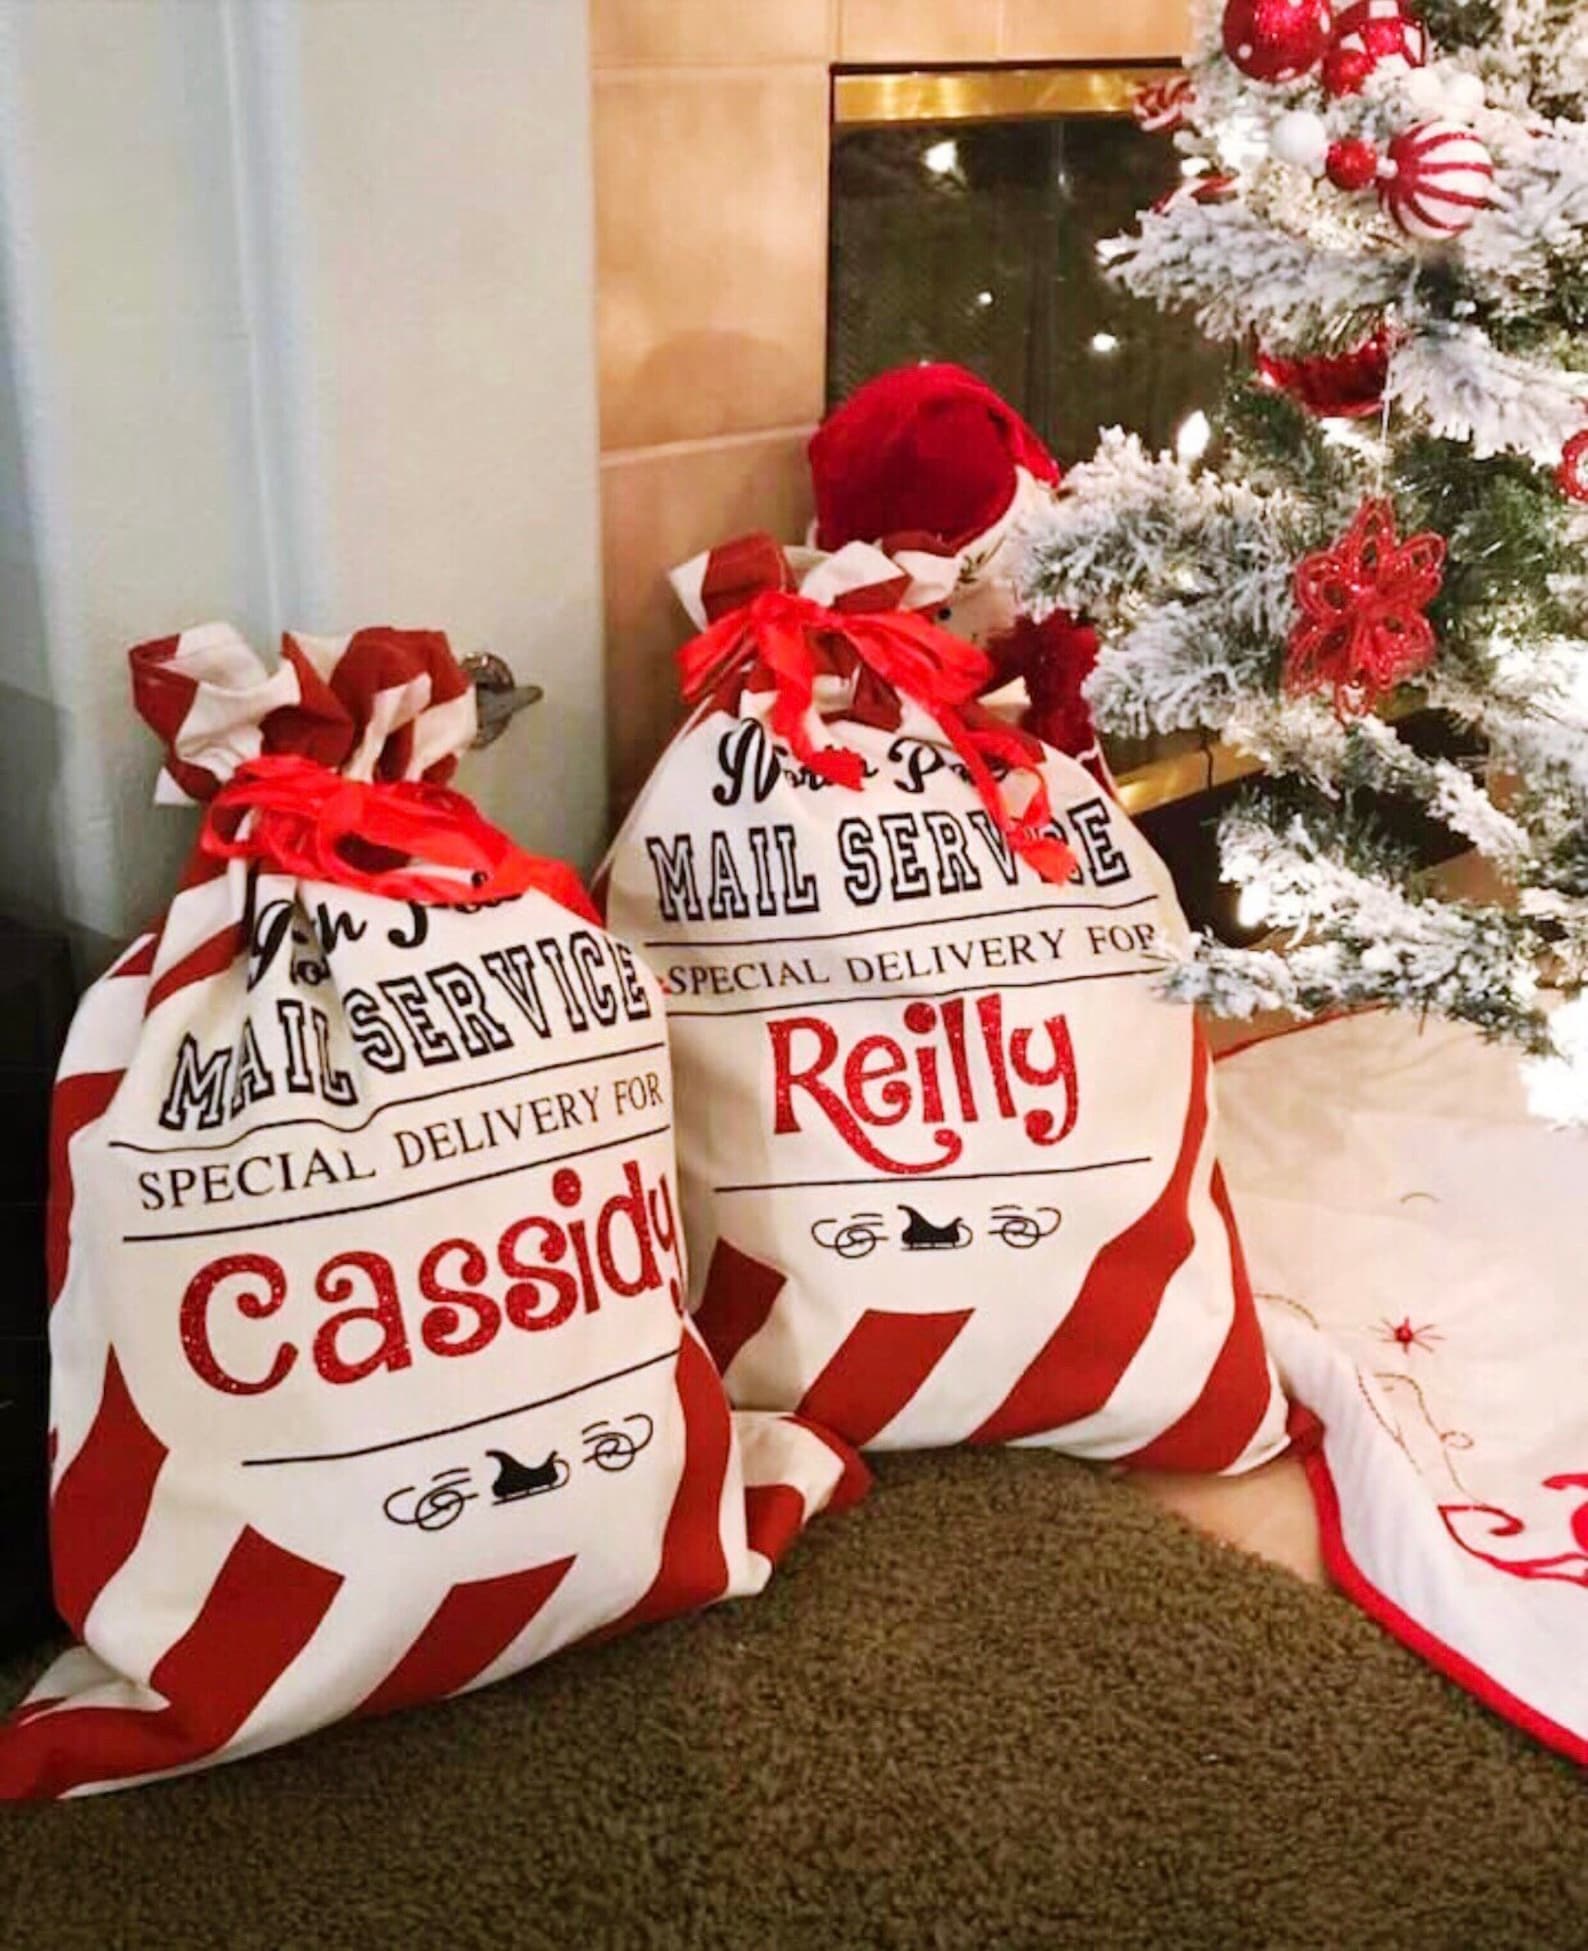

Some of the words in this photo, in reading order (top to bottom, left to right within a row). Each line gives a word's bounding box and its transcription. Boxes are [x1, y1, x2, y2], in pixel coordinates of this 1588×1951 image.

[646, 823, 820, 922] MAIL
[837, 797, 1132, 906] SERVE
[159, 999, 359, 1131] MAIL
[342, 930, 651, 1074] SERVICE
[669, 960, 831, 996] SPECIAL
[845, 927, 1066, 984] DELIVERY
[138, 1149, 377, 1211] SPECIAL
[392, 1085, 601, 1169] DELIVERY
[614, 1071, 663, 1114] FOR
[765, 992, 1080, 1175] Reilly
[179, 1159, 685, 1397] Cassidy
